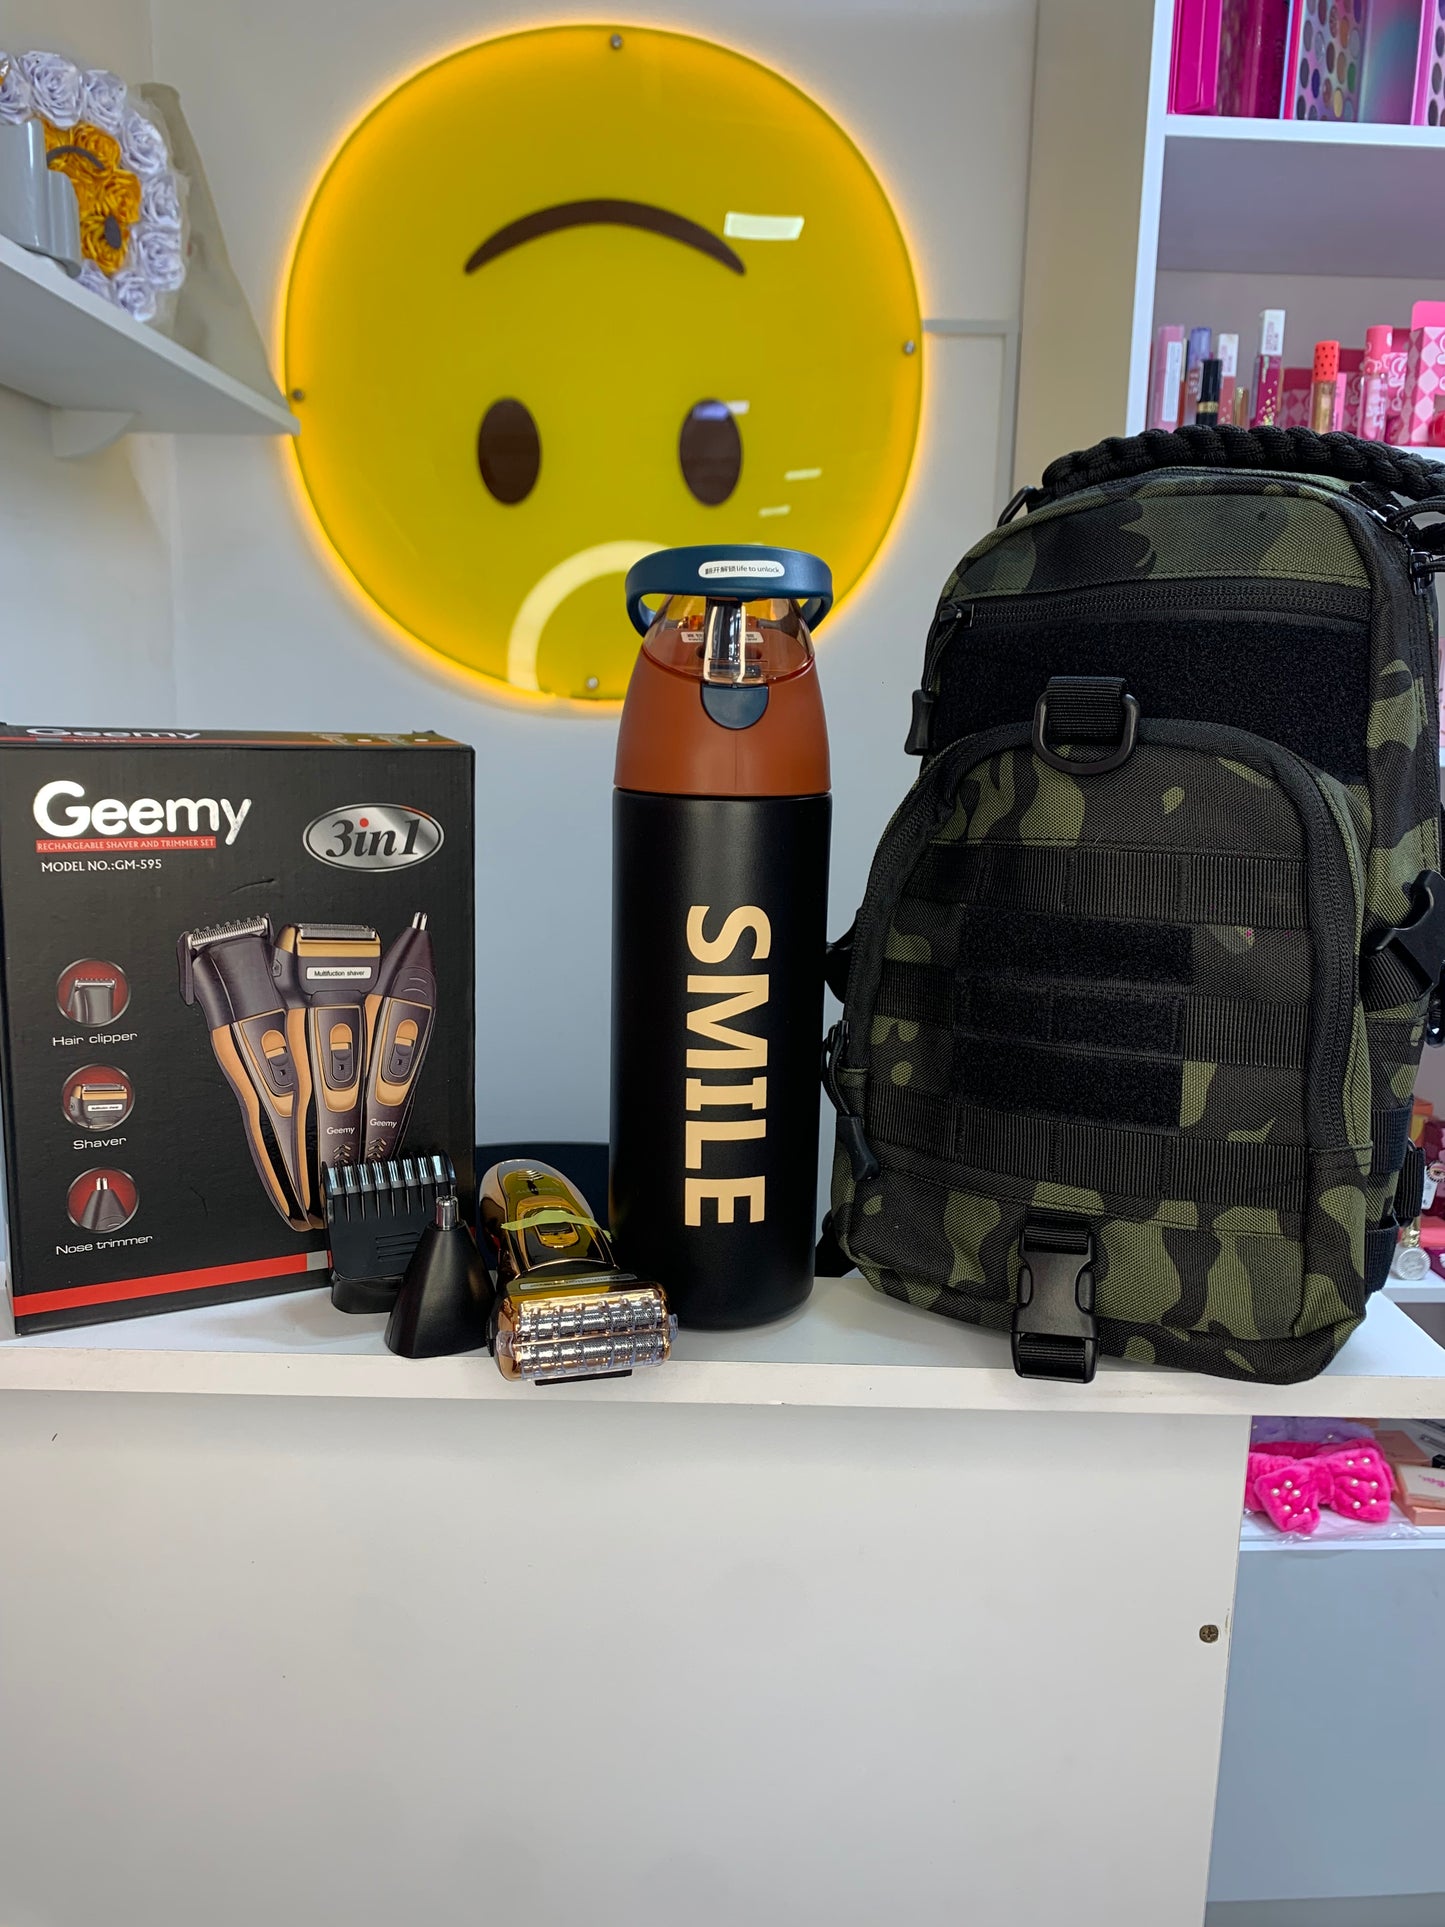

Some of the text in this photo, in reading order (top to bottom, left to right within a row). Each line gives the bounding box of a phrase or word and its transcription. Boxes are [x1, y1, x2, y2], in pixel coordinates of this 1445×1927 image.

[33, 780, 252, 845] Geemy
[37, 838, 215, 851] RECHARGEABLE SHAVER AND TRIMMER SET
[325, 818, 421, 857] 3in1
[41, 861, 85, 873] MODEL
[52, 1032, 138, 1046] Hair clipper
[685, 905, 771, 1226] SMILE
[370, 1118, 397, 1128] Geemy
[326, 1127, 355, 1135] Geemy
[73, 1136, 127, 1150] Shaver
[56, 1235, 153, 1256] Nose trimmer
